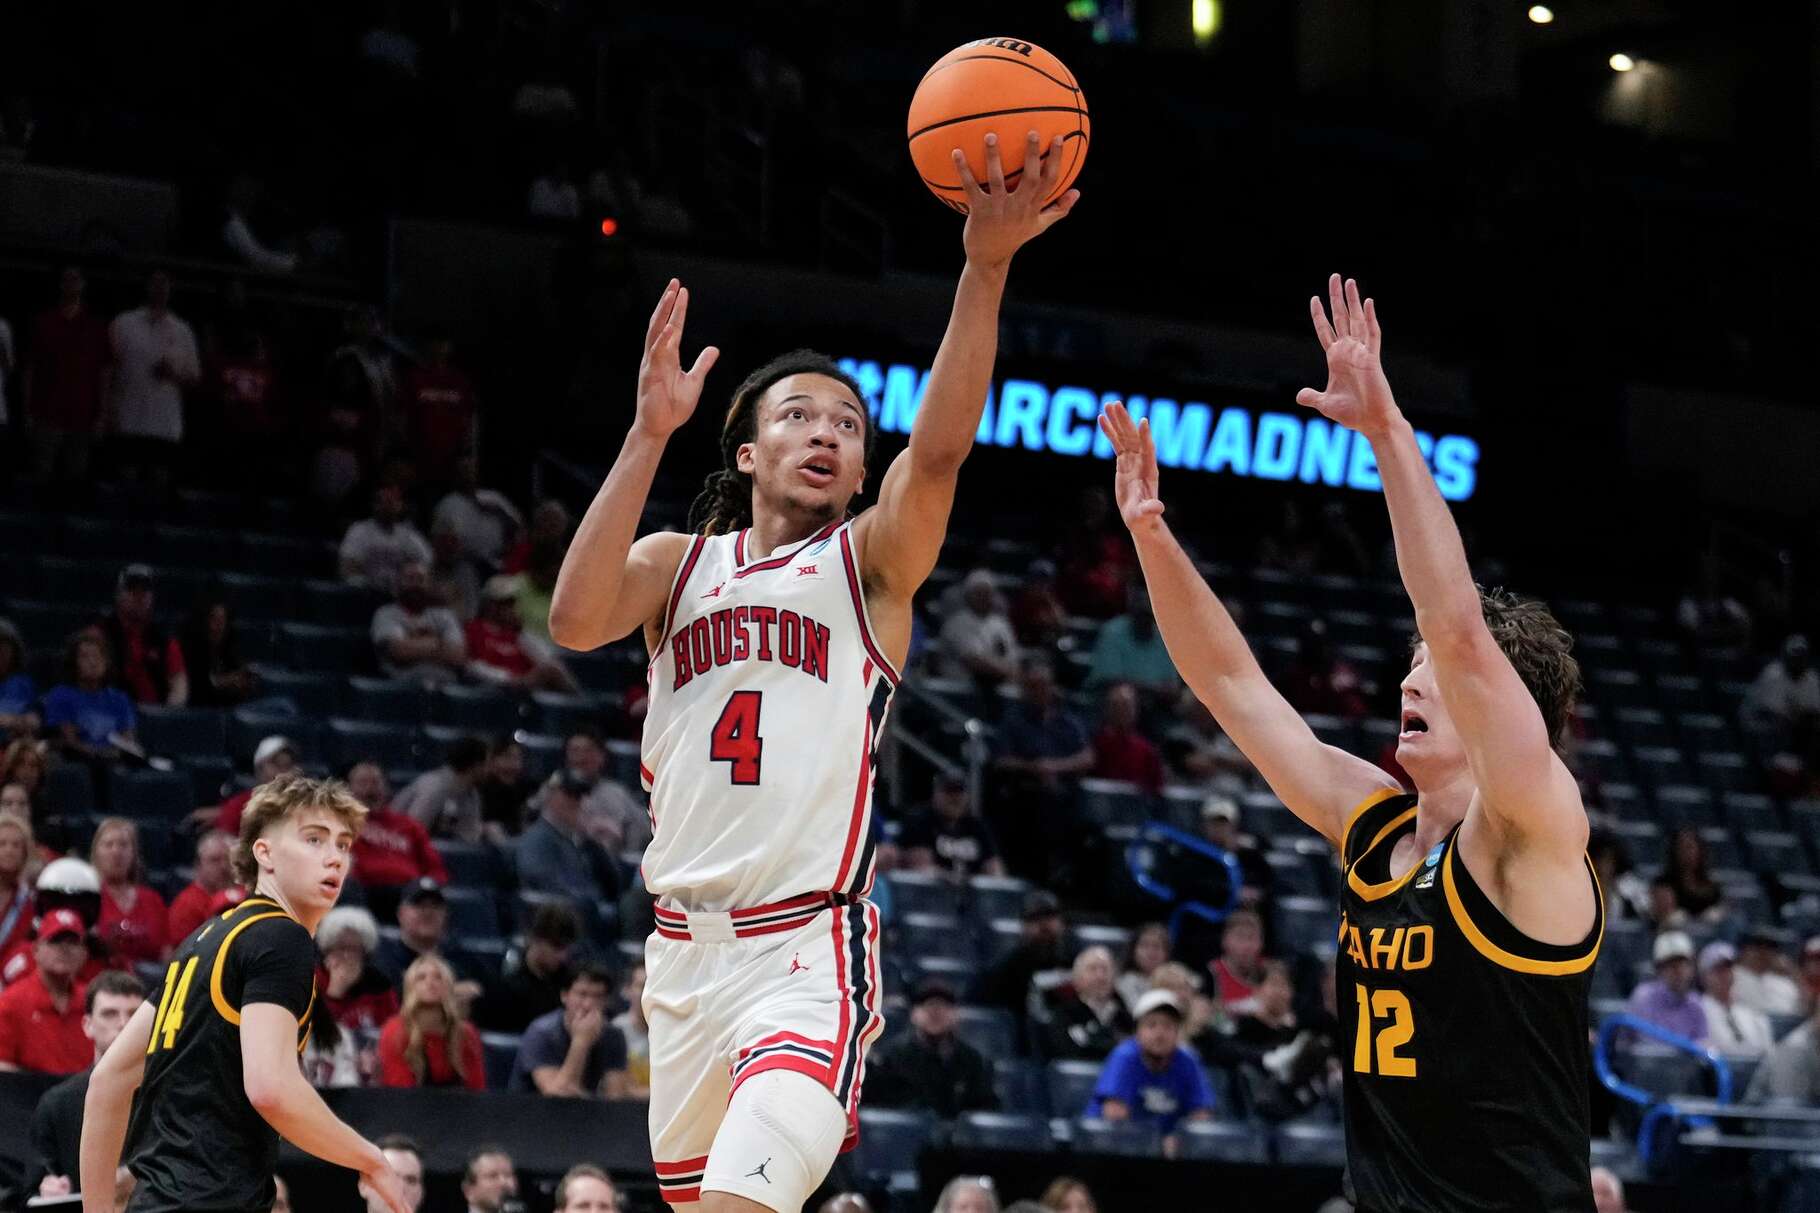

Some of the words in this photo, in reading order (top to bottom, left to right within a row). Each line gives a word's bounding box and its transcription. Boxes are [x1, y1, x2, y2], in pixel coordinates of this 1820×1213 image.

[838, 358, 1480, 502] #MRCMADNES
[671, 605, 830, 693] HOUSTON
[709, 690, 763, 786] 4
[147, 955, 199, 1055] 14
[1353, 982, 1417, 1078] 12
